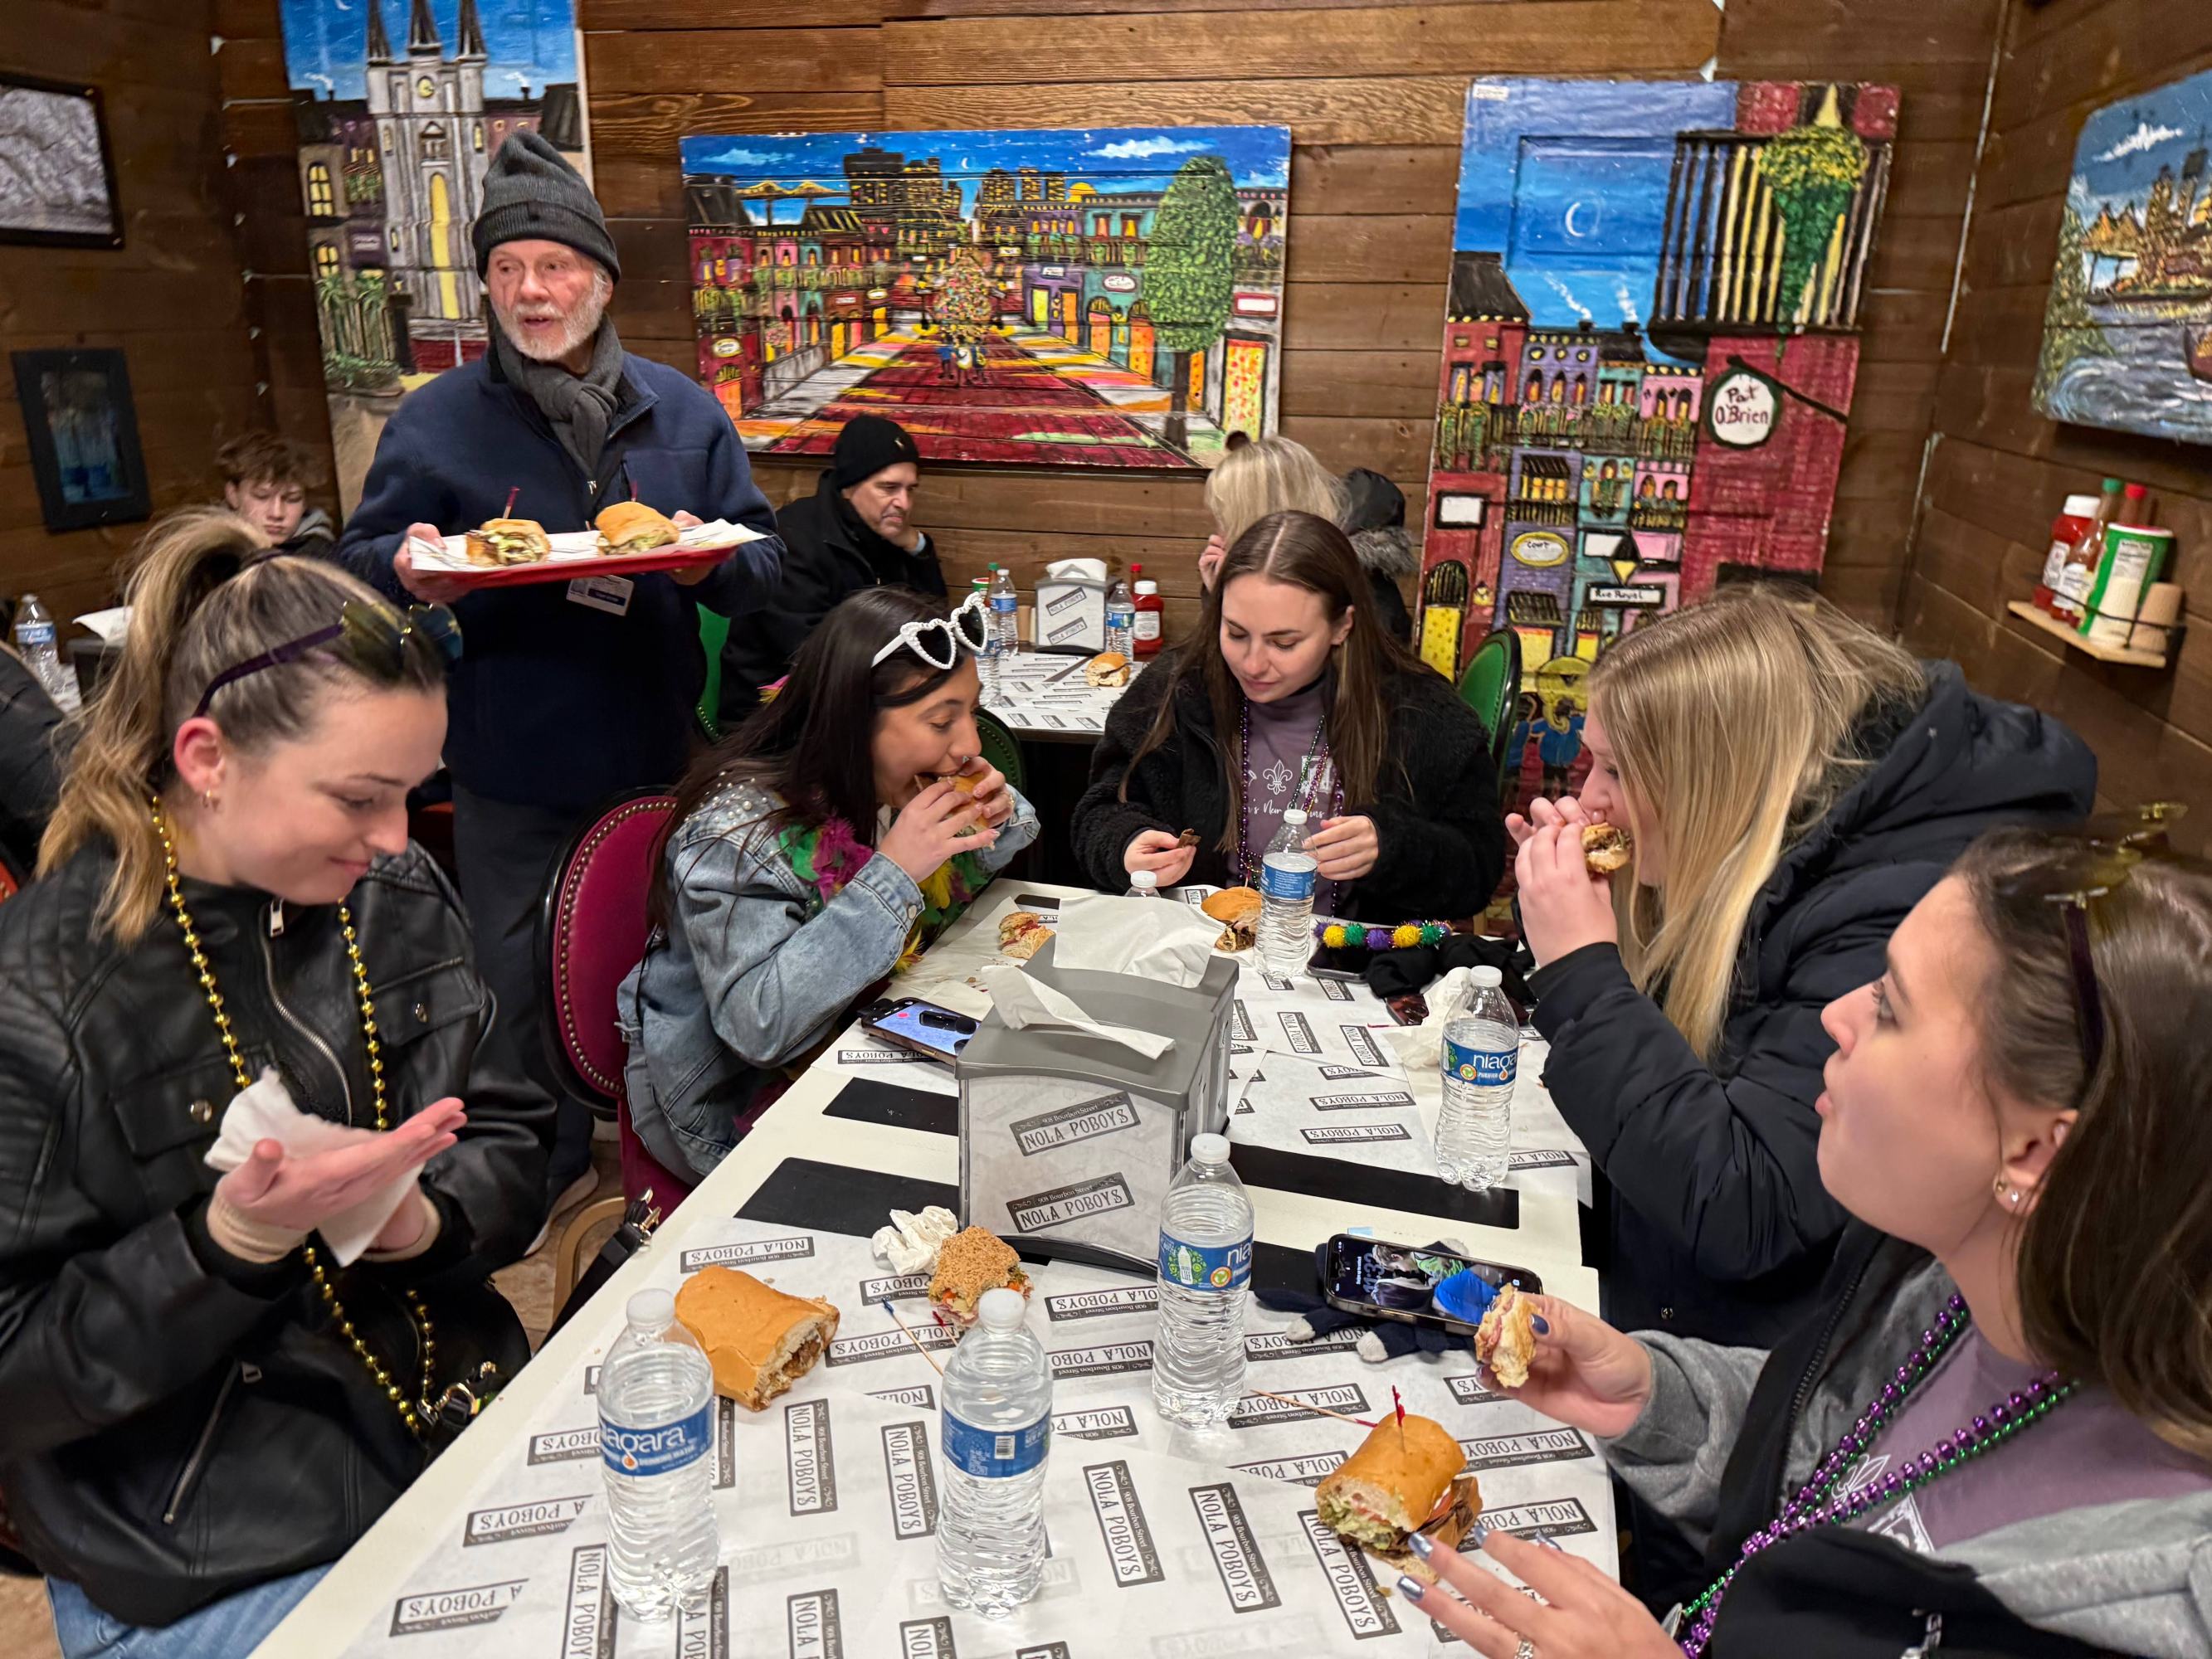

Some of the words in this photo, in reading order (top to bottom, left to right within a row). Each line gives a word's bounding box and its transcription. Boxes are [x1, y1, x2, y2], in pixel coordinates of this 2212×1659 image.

[1726, 384, 1757, 403] Pat
[1715, 404, 1769, 424] O'Brien
[1473, 1053, 1517, 1070] niaga
[1318, 1096, 1367, 1106] POBOYS
[1371, 1092, 1406, 1102] NOLA
[1024, 1126, 1065, 1150] NOLA
[1069, 1108, 1129, 1137] POBOYS
[1309, 1128, 1361, 1139] POBOYS
[1365, 1126, 1401, 1136] NOLA
[1050, 1190, 1075, 1201] Bourbon
[1074, 1184, 1094, 1194] Street
[1020, 1205, 1061, 1228] NOLA
[1065, 1189, 1123, 1216] POBOYS
[691, 1245, 754, 1262] POBOYS
[763, 1239, 805, 1253] NOLA
[1056, 1292, 1120, 1310] POBOYS
[1127, 1289, 1157, 1301] OLA
[835, 1333, 903, 1355] POBOYS
[1103, 1345, 1149, 1360] NOLA
[1051, 1351, 1095, 1367] POBO
[1308, 1389, 1356, 1406] NOLA
[791, 1408, 811, 1443] NOLA
[1076, 1411, 1125, 1428] NOLA
[543, 1431, 601, 1451] OBOYS
[889, 1430, 911, 1467] NOLA
[1466, 1438, 1521, 1457] POBOY
[1527, 1432, 1576, 1450] NOLA
[794, 1449, 817, 1506] POBOYS
[821, 1462, 830, 1481] Street
[918, 1461, 929, 1486] Bourbon
[922, 1486, 932, 1505] Street
[1092, 1471, 1119, 1510] NOLA
[895, 1473, 922, 1530] POBOYS
[480, 1503, 561, 1530] POBOYS
[1524, 1503, 1578, 1524] NOLA
[1126, 1502, 1141, 1529] Bourbon
[1136, 1528, 1147, 1548] Street
[1105, 1515, 1141, 1576] POBOYS
[1197, 1493, 1228, 1533] NOLA
[1216, 1540, 1256, 1602] POBOYS
[1235, 1525, 1251, 1554] Bourbon
[1247, 1553, 1261, 1573] Street
[576, 1552, 602, 1593] NOLA
[1349, 1551, 1366, 1578] Bourbon
[1363, 1577, 1379, 1598] Street
[409, 1589, 496, 1618] POBOYS
[1330, 1564, 1376, 1628] POBOYS
[570, 1603, 597, 1659] POBOY
[795, 1600, 820, 1647] NOLA
